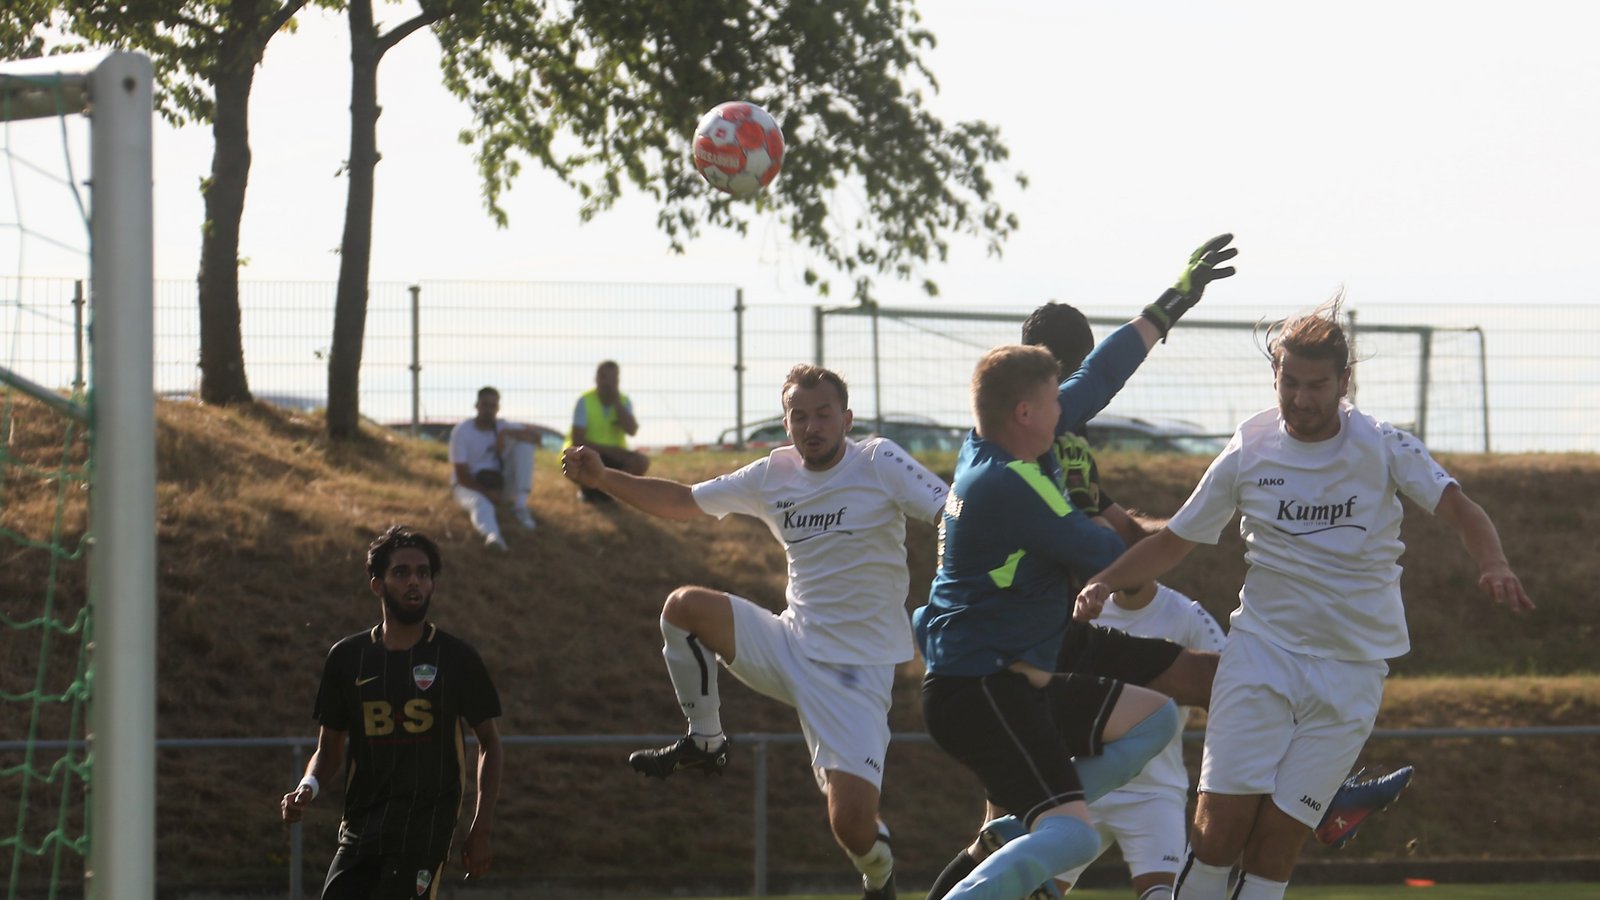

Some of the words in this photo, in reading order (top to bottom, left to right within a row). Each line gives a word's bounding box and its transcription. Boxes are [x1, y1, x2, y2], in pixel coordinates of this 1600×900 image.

[1257, 478, 1285, 487] JAKO
[784, 506, 848, 531] Kumpf
[1276, 495, 1358, 525] Kumpf
[1300, 794, 1322, 811] JAKO
